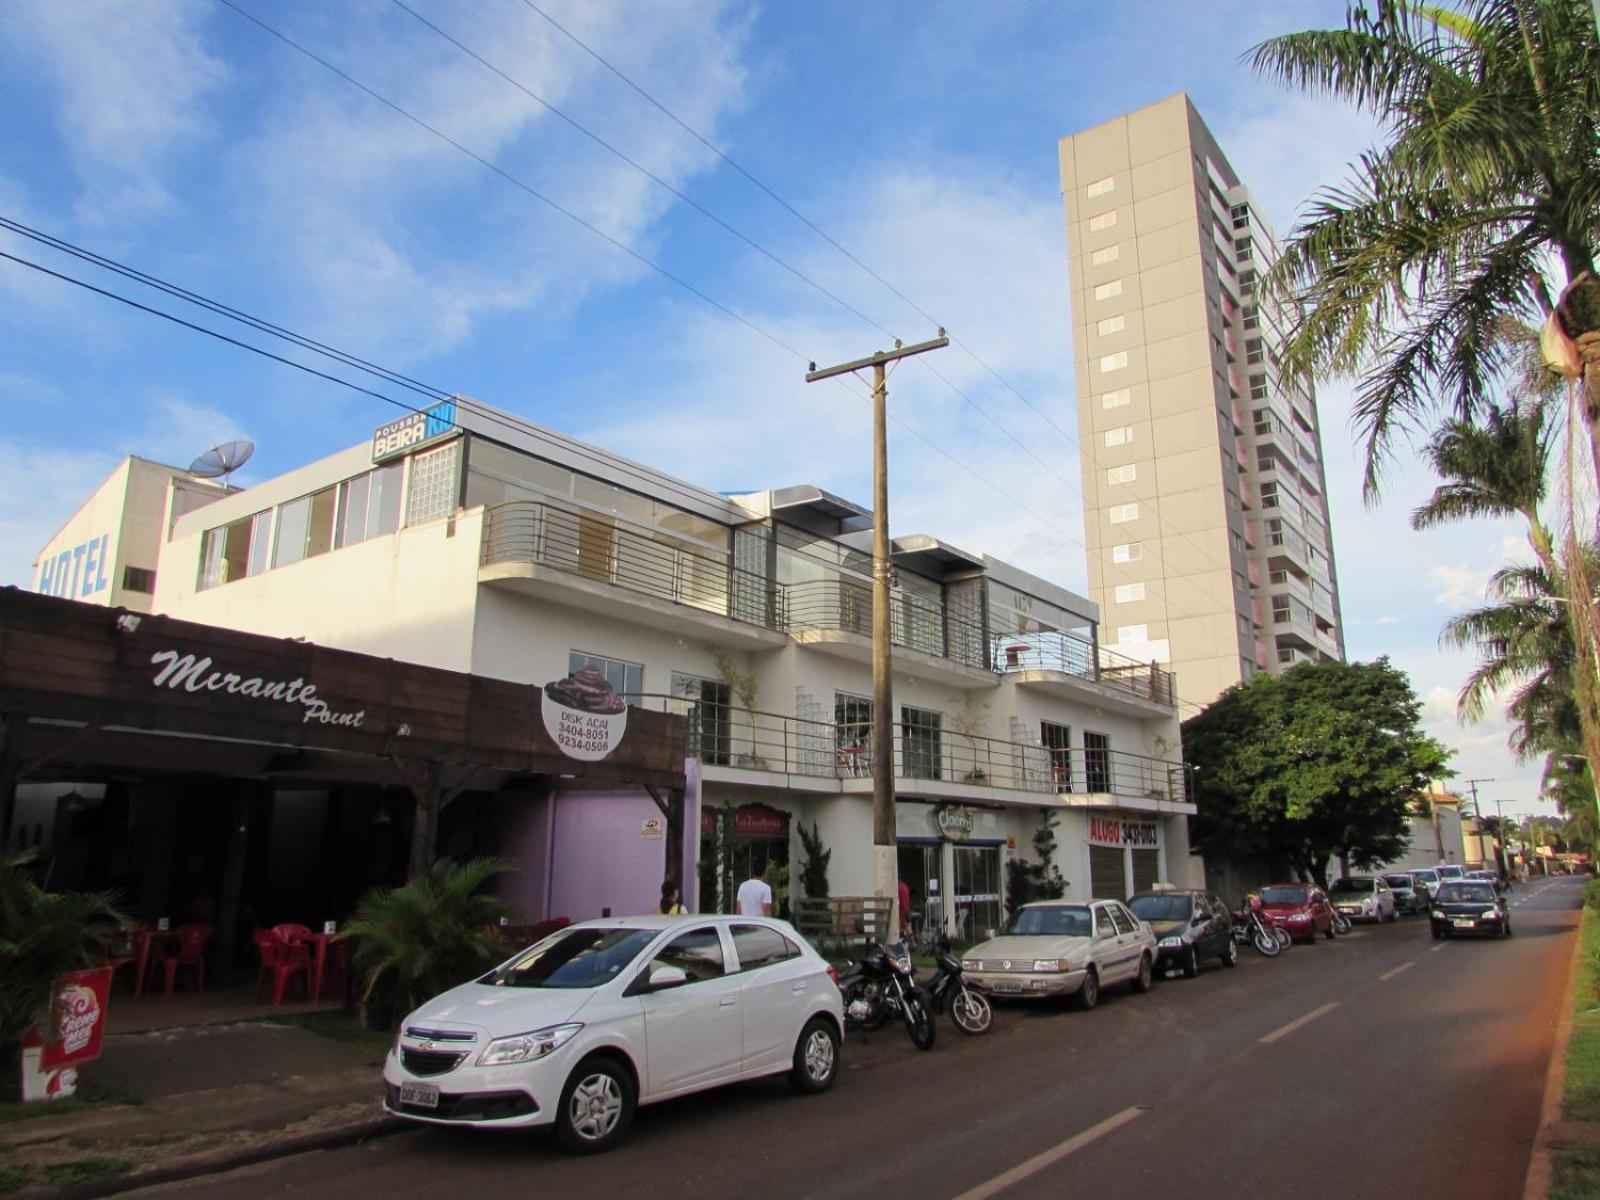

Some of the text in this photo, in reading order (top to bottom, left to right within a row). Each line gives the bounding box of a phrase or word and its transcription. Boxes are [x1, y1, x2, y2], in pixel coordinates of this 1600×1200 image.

[374, 401, 457, 458] BEIRA RIO
[39, 533, 108, 600] HOTEL
[151, 650, 317, 703] Mirante
[303, 699, 365, 728] Point
[561, 711, 583, 725] DISK
[557, 733, 609, 752] 9234-0506
[558, 722, 609, 740] 3404-8051
[1090, 816, 1120, 843] ALUGO
